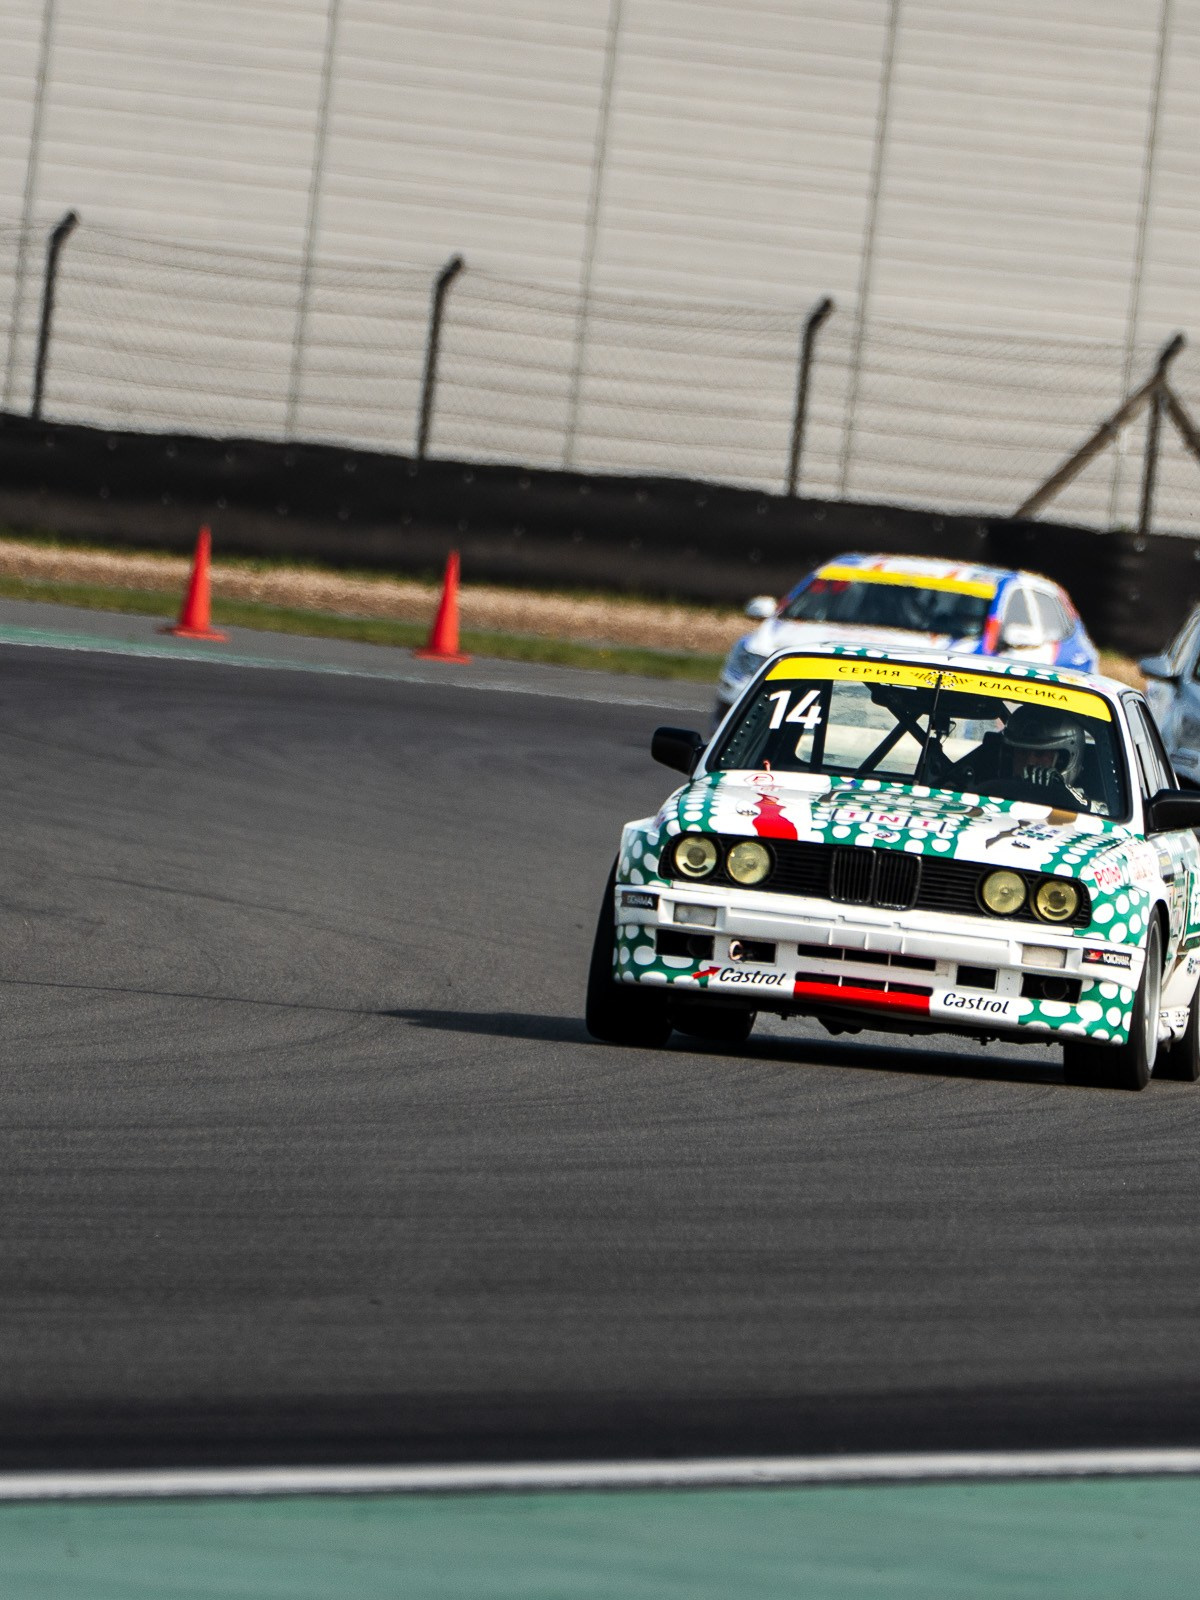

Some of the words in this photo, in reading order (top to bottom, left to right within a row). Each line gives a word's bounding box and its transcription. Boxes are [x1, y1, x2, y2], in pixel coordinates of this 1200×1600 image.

[838, 665, 900, 678] СЕРИЯ
[979, 680, 1069, 702] КЛАССИКА
[768, 690, 822, 730] 14
[720, 967, 787, 986] Castrol
[943, 992, 1010, 1015] Castrol
